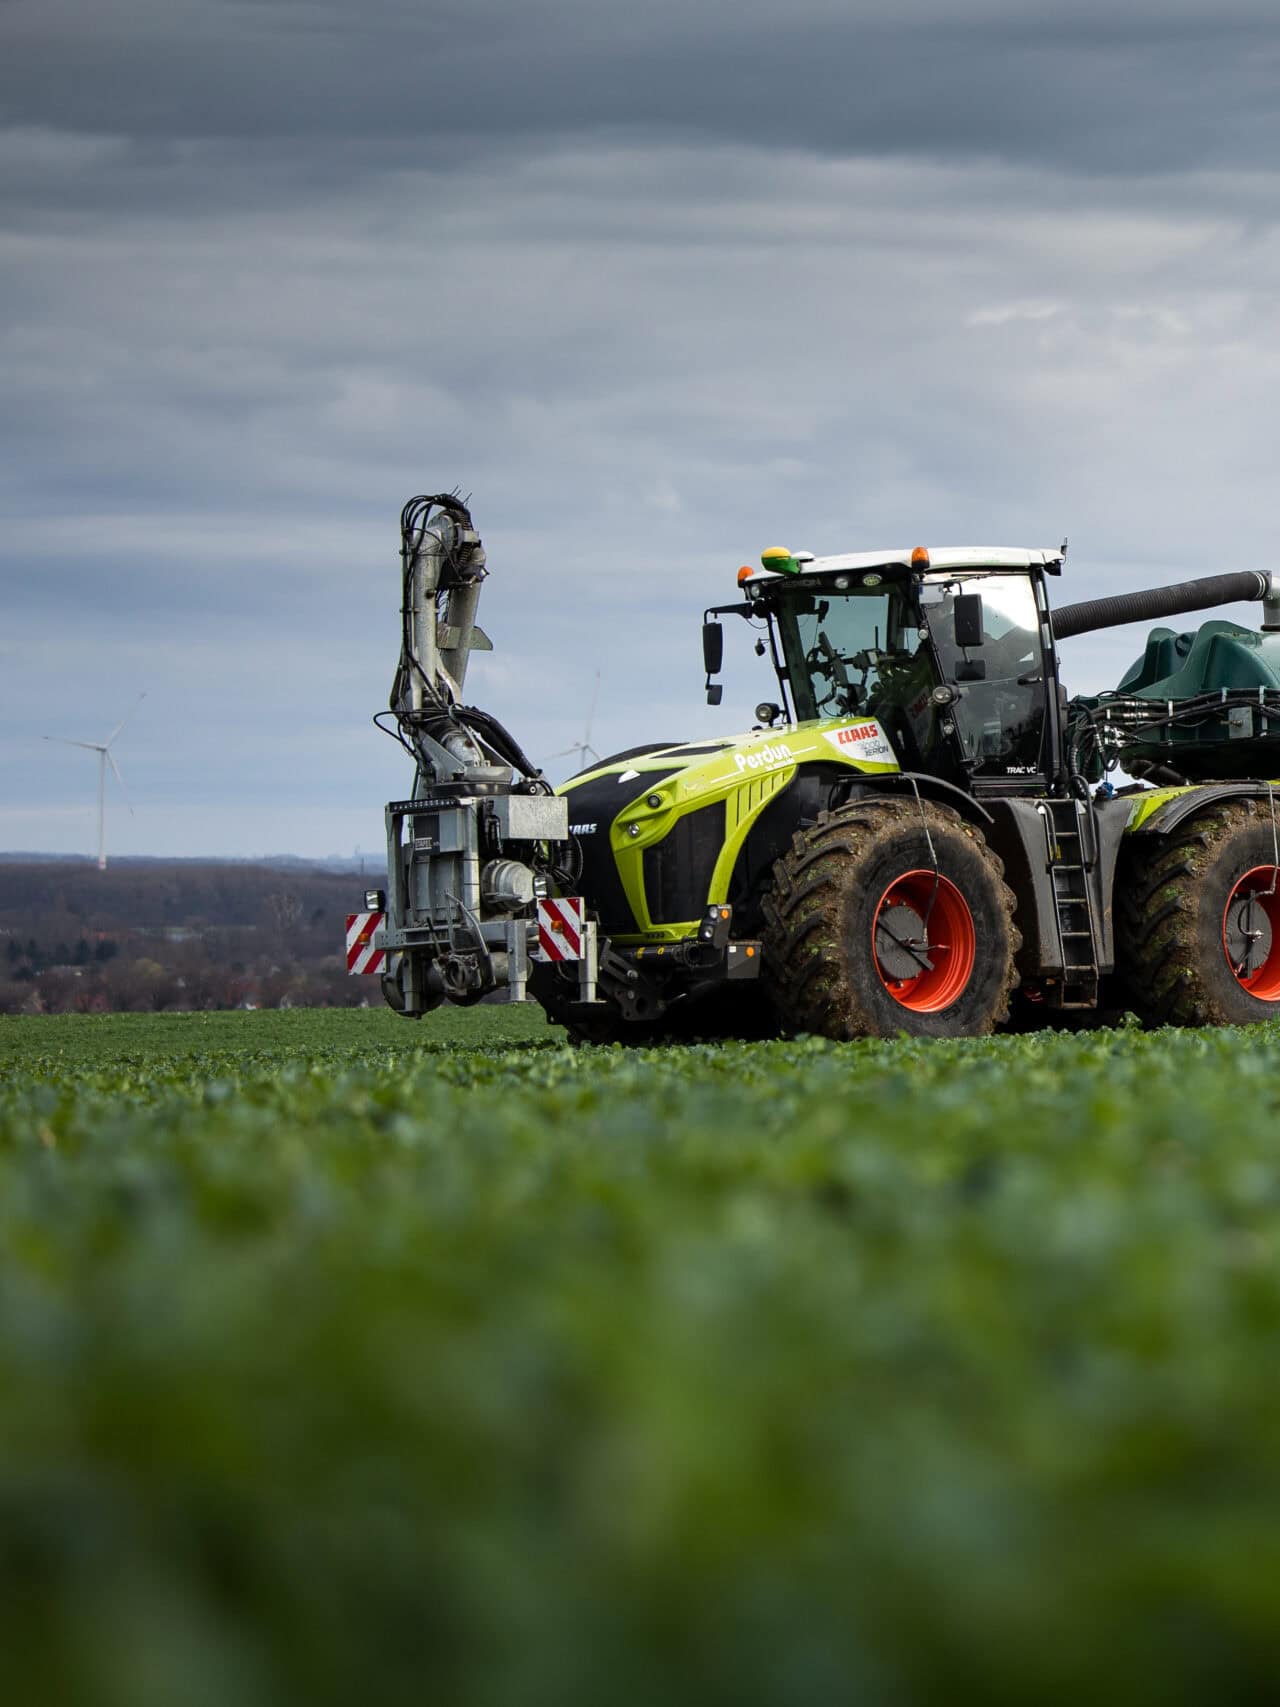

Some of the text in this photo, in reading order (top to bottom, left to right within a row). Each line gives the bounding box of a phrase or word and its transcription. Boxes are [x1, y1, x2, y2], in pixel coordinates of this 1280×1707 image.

[837, 724, 878, 744] CLAAS
[734, 743, 792, 772] Perdun
[1006, 766, 1037, 774] TRAC VC
